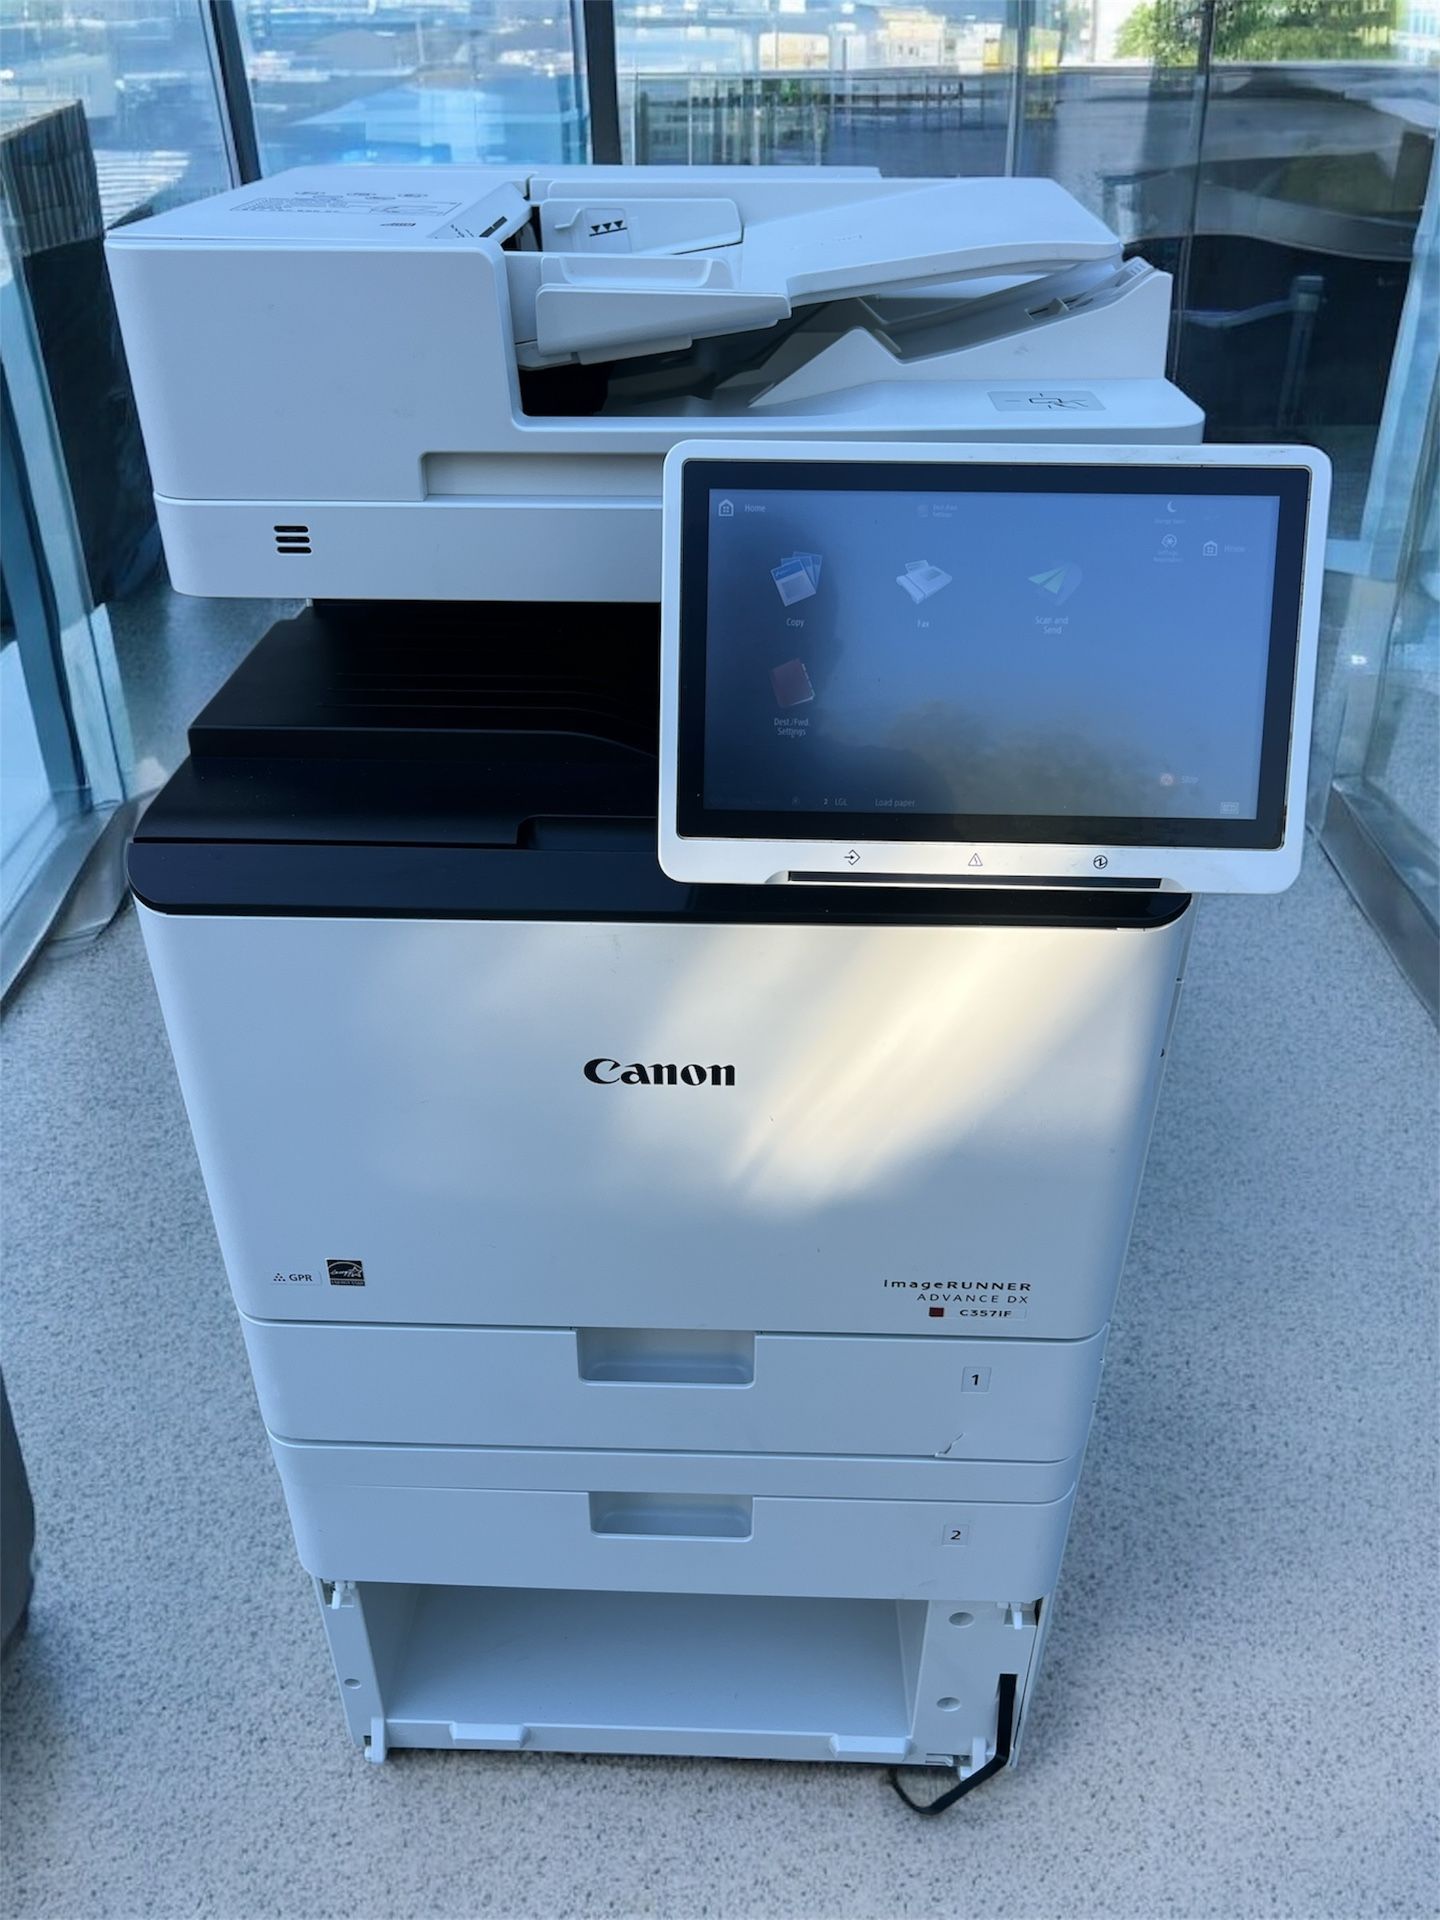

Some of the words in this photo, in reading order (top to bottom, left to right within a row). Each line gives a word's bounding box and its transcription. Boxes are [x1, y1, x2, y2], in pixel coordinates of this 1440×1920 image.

[744, 503, 767, 513] Home
[786, 617, 806, 628] Copy
[1034, 615, 1053, 625] Scan
[1054, 616, 1069, 625] and
[1043, 626, 1062, 635] Send
[874, 798, 893, 807] Load
[583, 1058, 735, 1086] Canon
[288, 1273, 313, 1282] GPR
[916, 1293, 999, 1304] ADVANCE
[1007, 1295, 1029, 1304] DX
[971, 1374, 980, 1386] 1
[950, 1530, 961, 1541] 2
